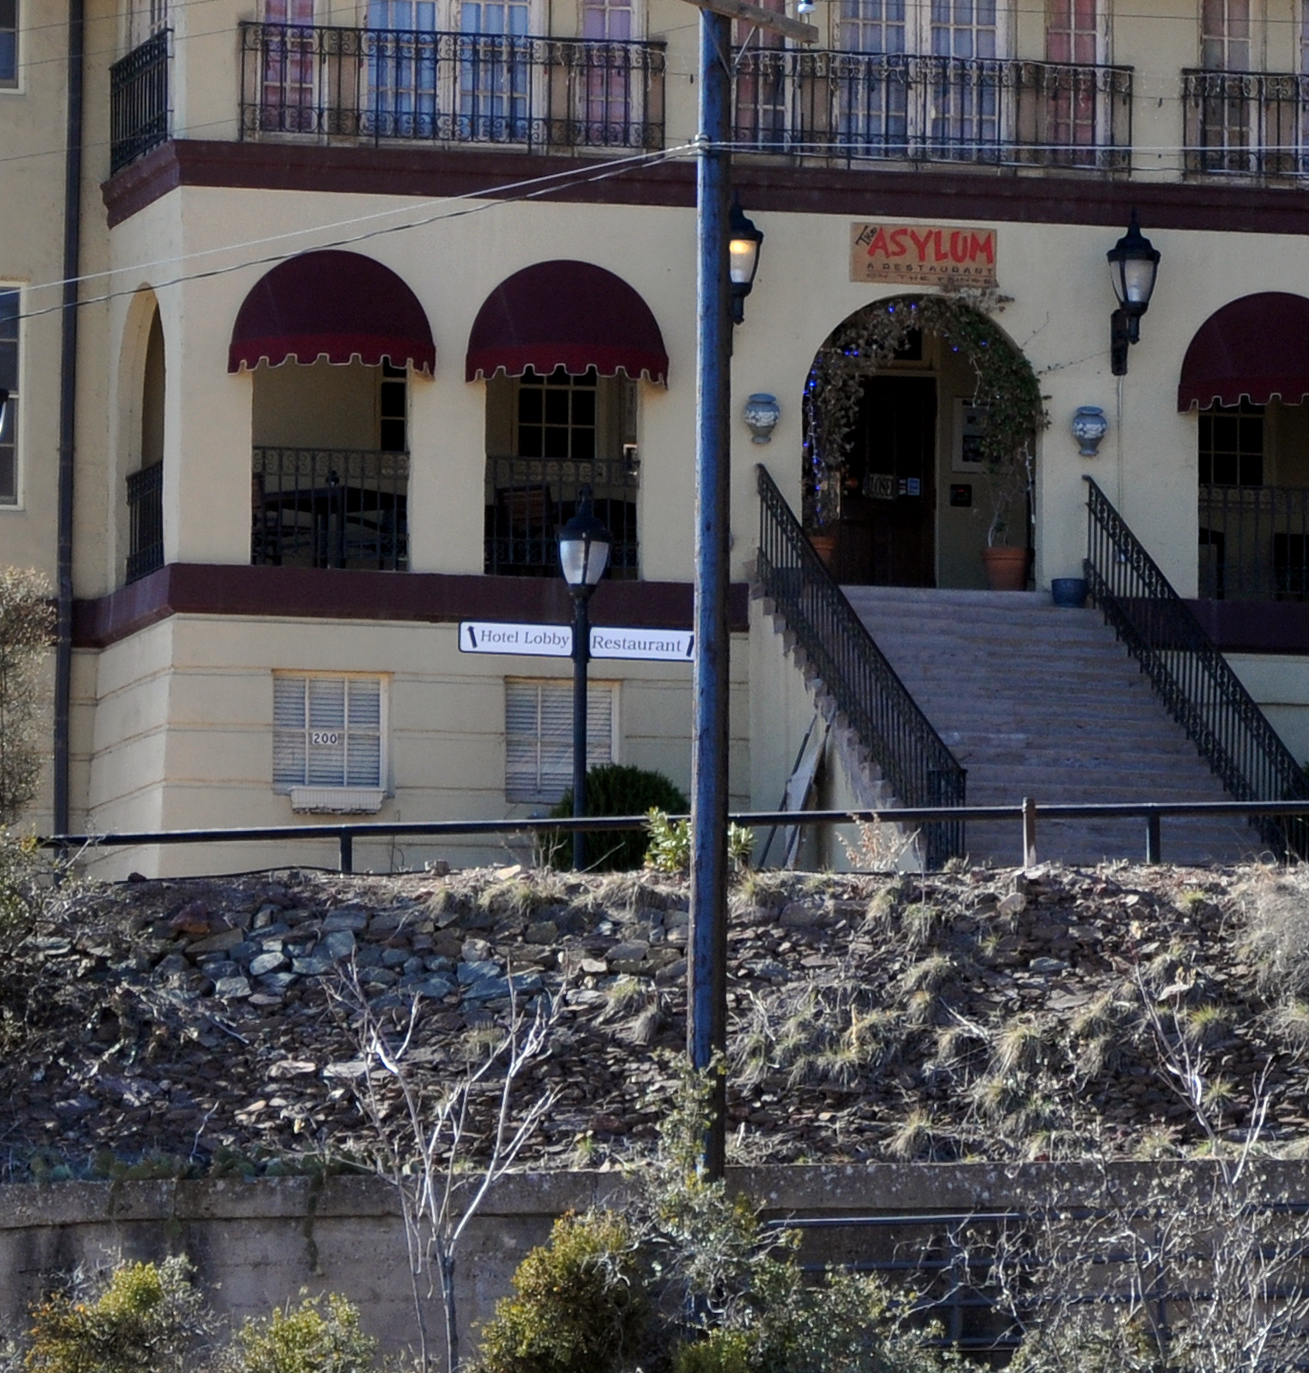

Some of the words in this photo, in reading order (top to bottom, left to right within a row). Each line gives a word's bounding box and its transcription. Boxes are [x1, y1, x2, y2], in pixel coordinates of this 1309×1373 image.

[867, 227, 994, 264] ASYLUM
[883, 263, 994, 275] RESTAURANT
[480, 629, 519, 644] Hotel
[523, 631, 570, 650] Lobby
[592, 636, 682, 653] Restaurant
[314, 733, 338, 744] 200
